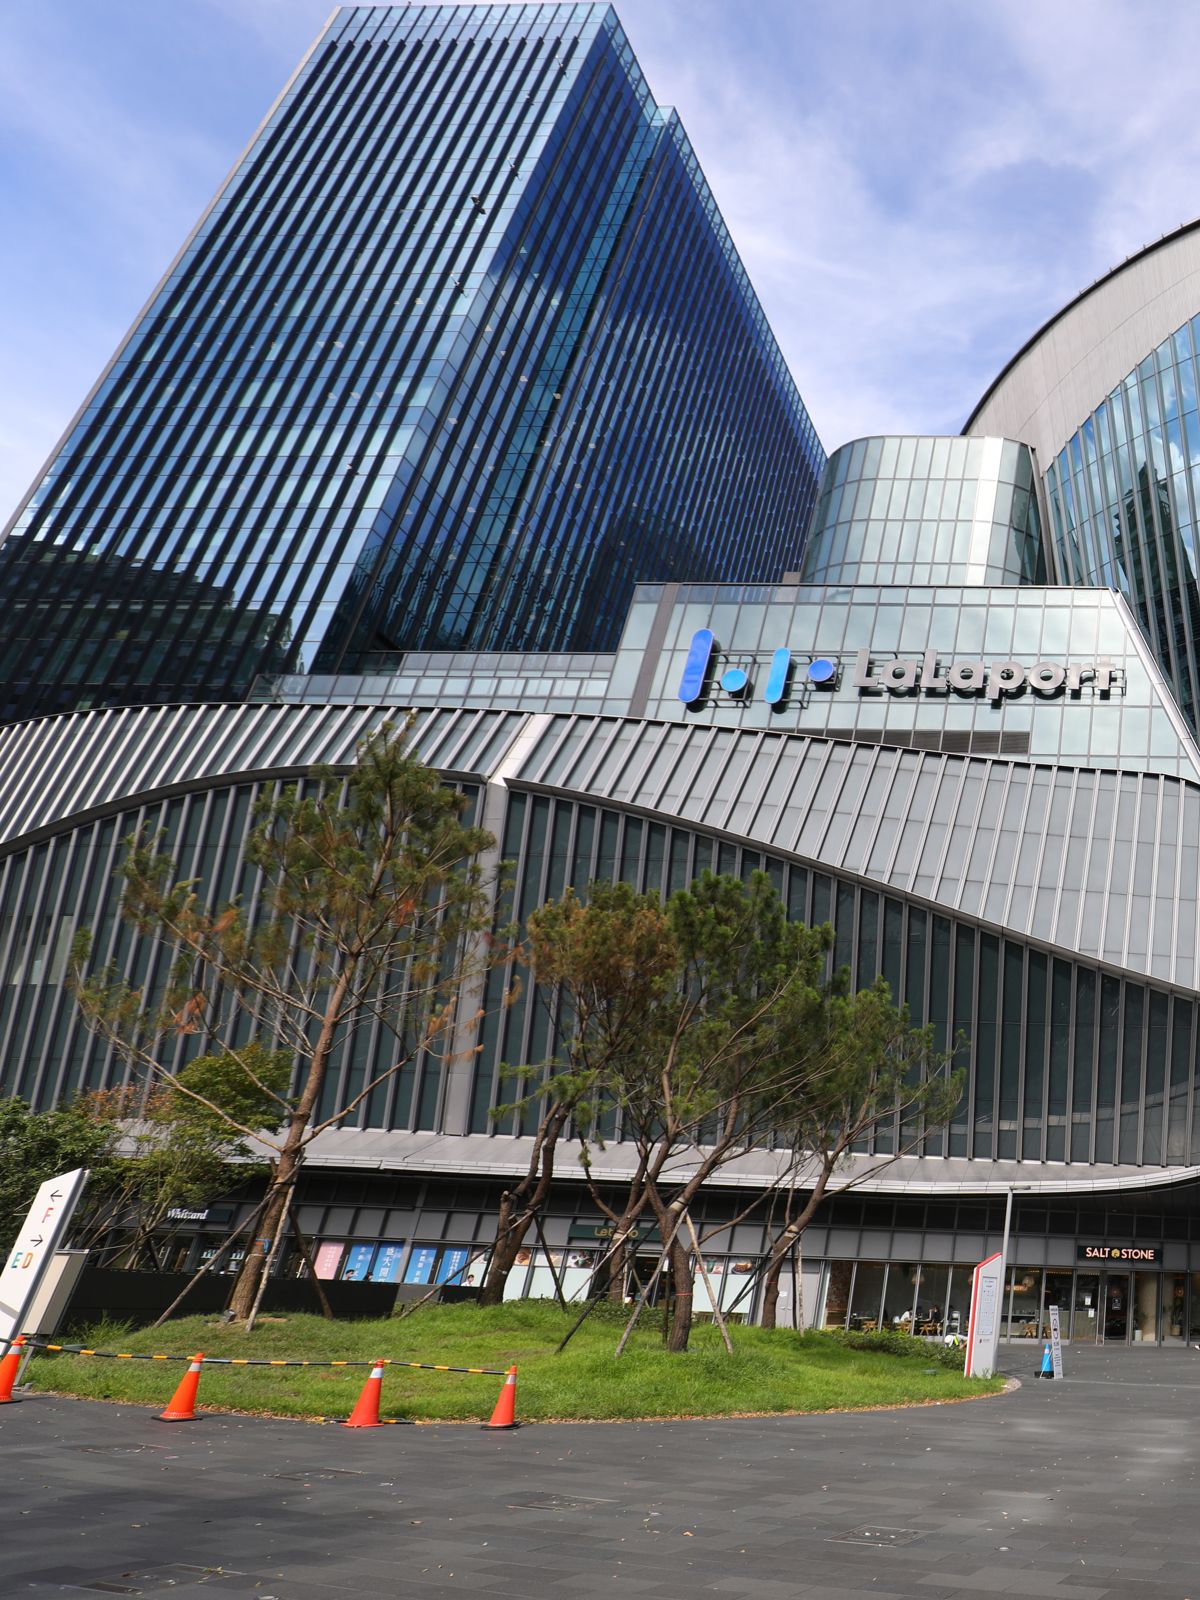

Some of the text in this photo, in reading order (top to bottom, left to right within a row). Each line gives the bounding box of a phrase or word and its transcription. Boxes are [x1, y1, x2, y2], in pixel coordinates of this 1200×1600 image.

[853, 647, 1118, 701] LaLaport
[42, 1207, 54, 1223] F
[1085, 1246, 1155, 1260] SALT STONE
